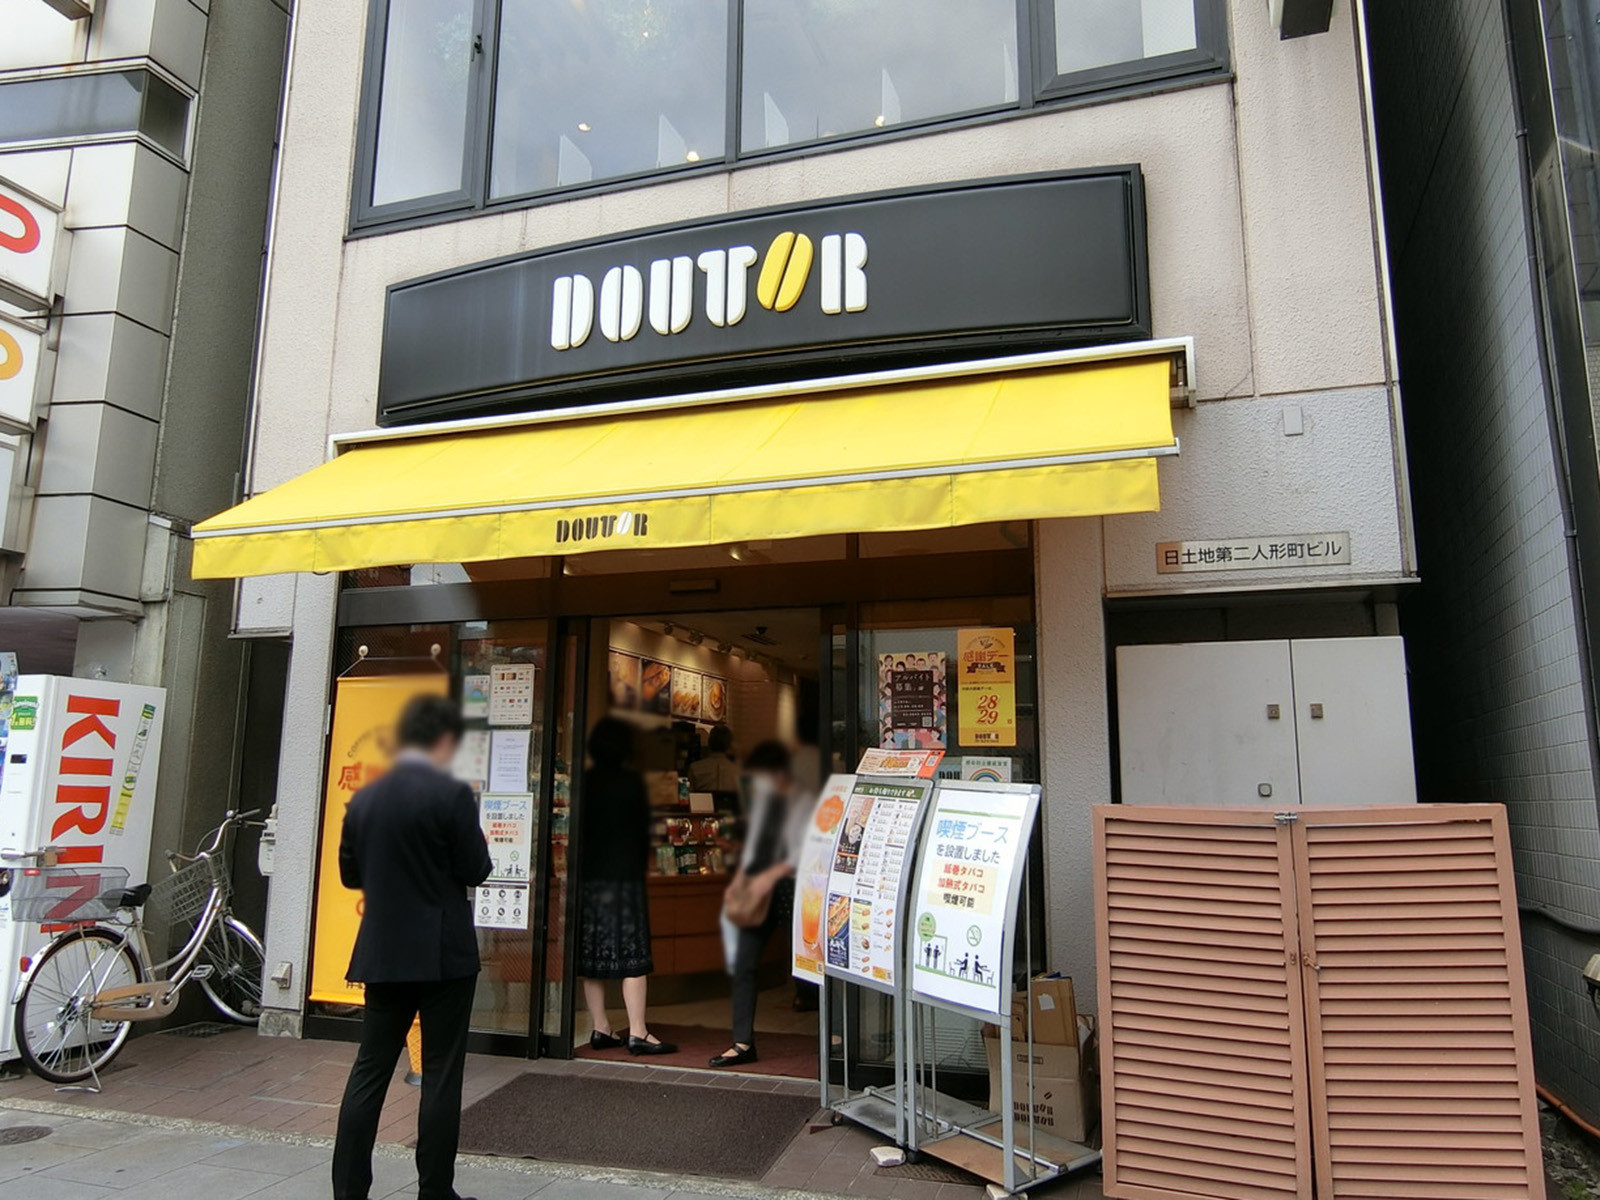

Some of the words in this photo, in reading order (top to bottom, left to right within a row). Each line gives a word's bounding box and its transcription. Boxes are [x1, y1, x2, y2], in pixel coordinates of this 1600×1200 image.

[550, 231, 868, 351] DOUTOR
[556, 511, 648, 543] DOUTOR
[1164, 540, 1342, 566] 日土地第二人形町ビル
[977, 694, 999, 710] 28
[977, 709, 999, 725] 29
[40, 694, 121, 933] KIRIN
[936, 819, 1009, 844] 喫煙ブース
[936, 844, 1001, 864] を設置しました
